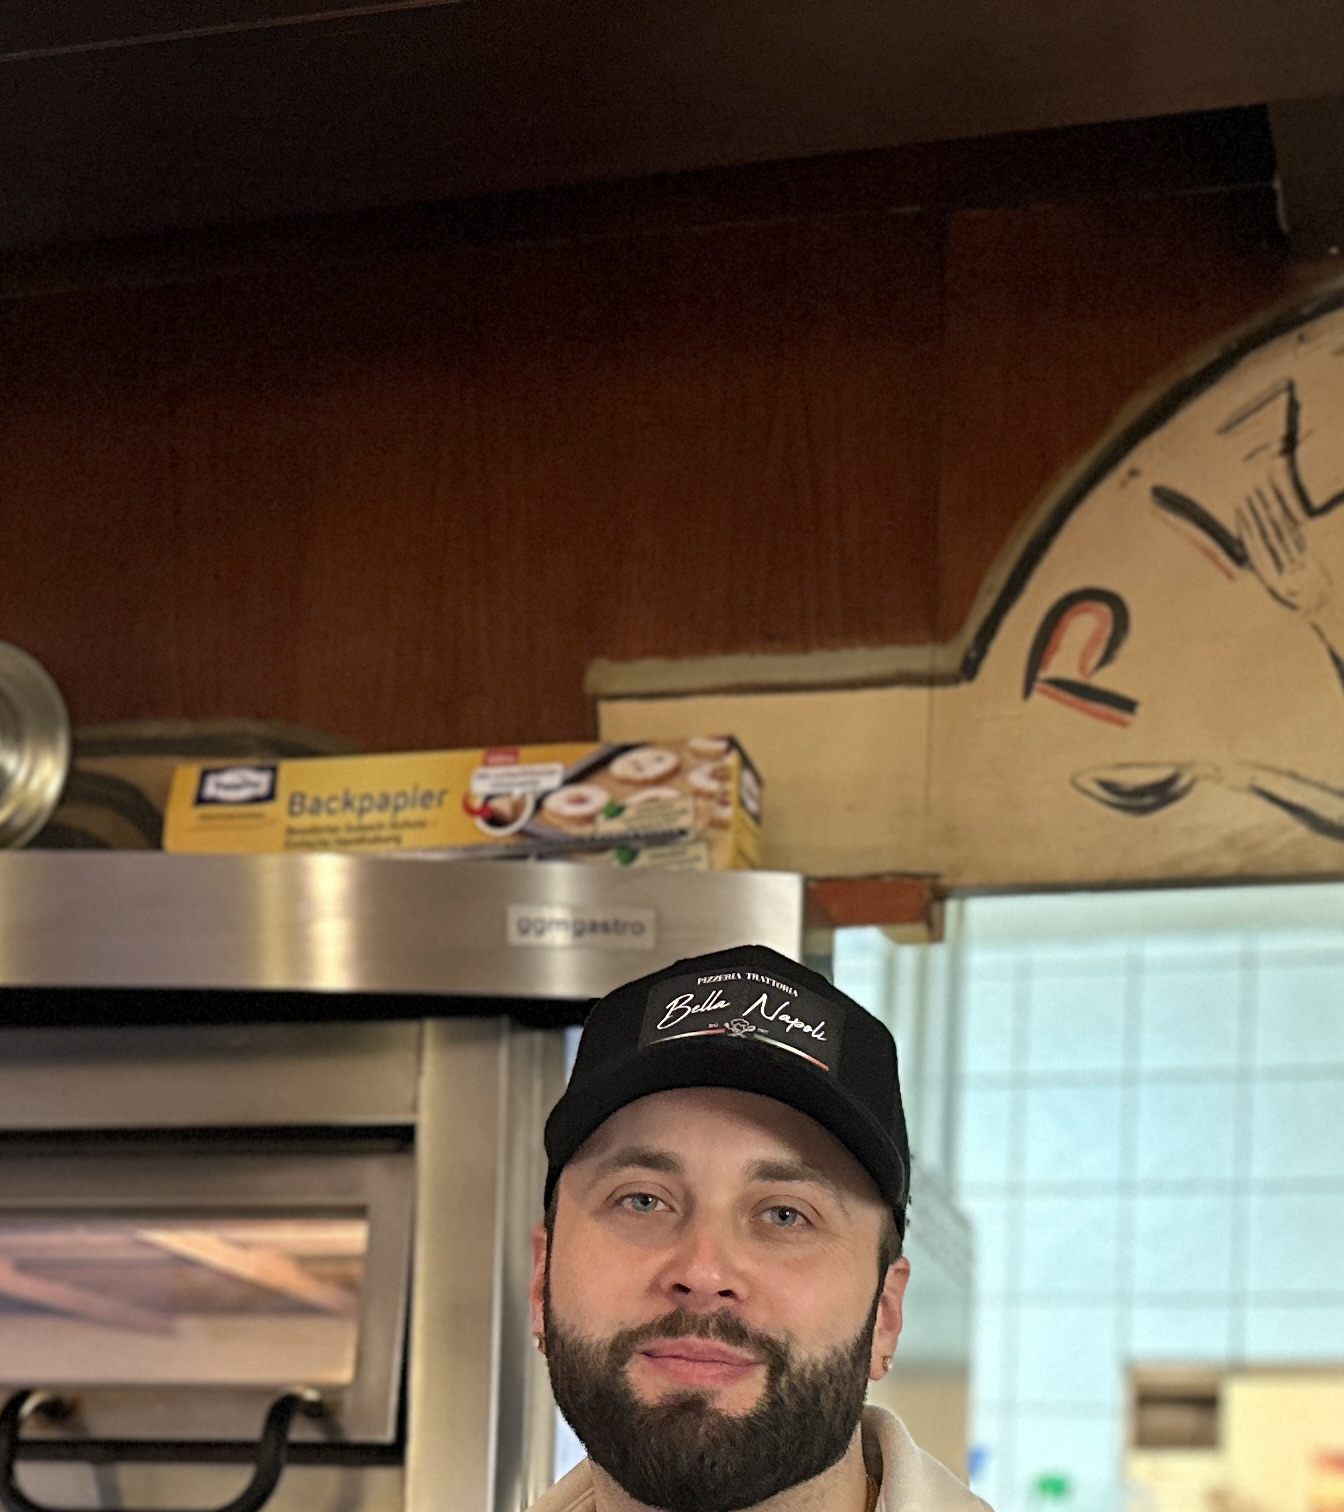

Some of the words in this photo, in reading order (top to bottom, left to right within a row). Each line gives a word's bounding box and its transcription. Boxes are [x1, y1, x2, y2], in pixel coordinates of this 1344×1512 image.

[288, 785, 449, 819] Backpapier
[697, 972, 742, 985] PIZZERIA
[746, 972, 798, 997] TRATTORIA
[657, 989, 731, 1030] Bella
[742, 993, 827, 1041] Napoli
